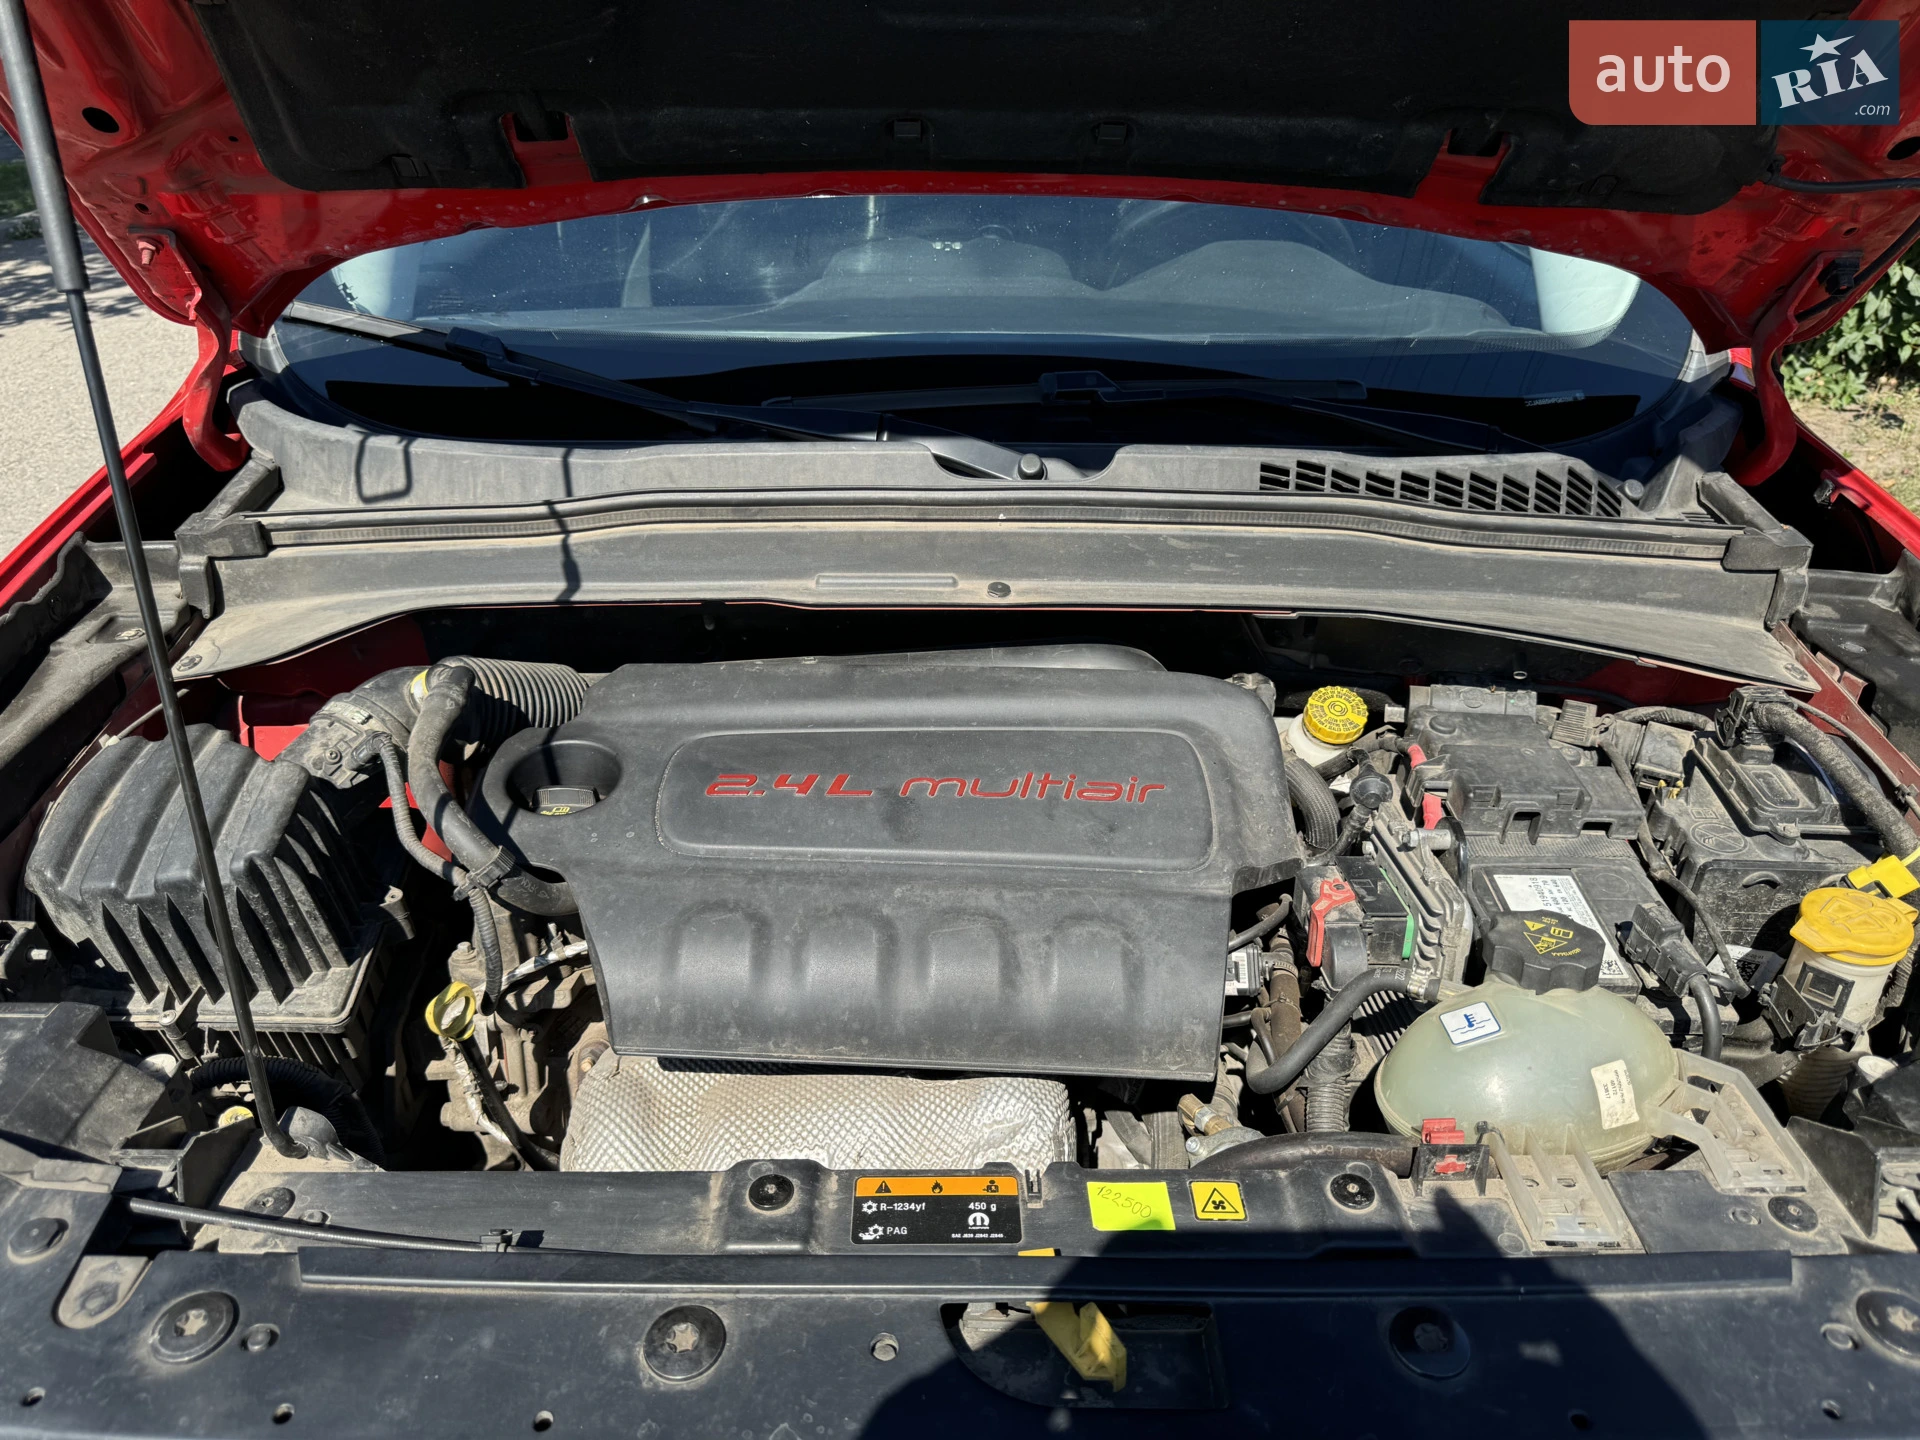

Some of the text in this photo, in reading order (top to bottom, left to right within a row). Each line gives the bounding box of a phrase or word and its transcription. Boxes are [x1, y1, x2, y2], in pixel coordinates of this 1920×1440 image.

[899, 771, 1166, 804] multiair
[880, 1202, 997, 1212] R-1234yf 450 g
[886, 1226, 908, 1235] PAG
